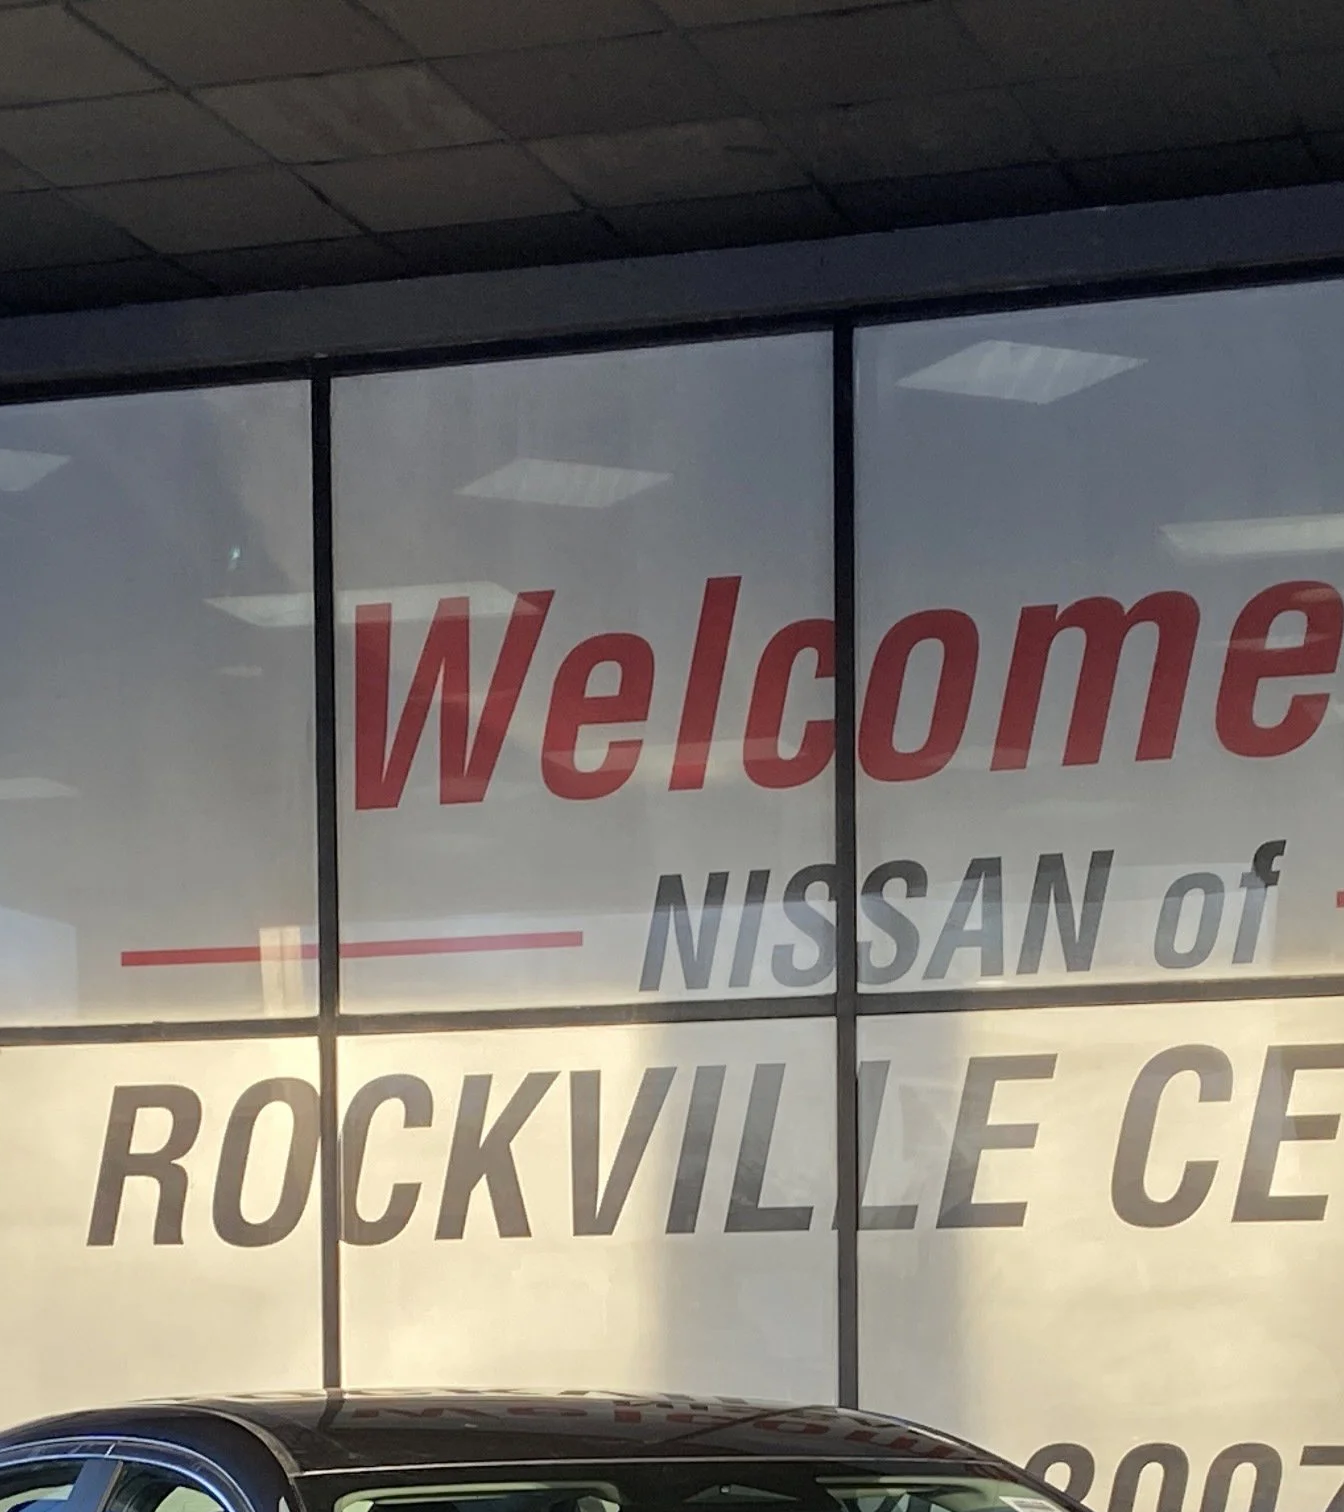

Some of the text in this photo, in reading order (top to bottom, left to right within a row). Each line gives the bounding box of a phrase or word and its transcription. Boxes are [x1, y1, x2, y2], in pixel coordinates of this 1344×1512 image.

[639, 839, 1287, 992] NISSAN of
[87, 1053, 1056, 1248] ROCKVILLE
